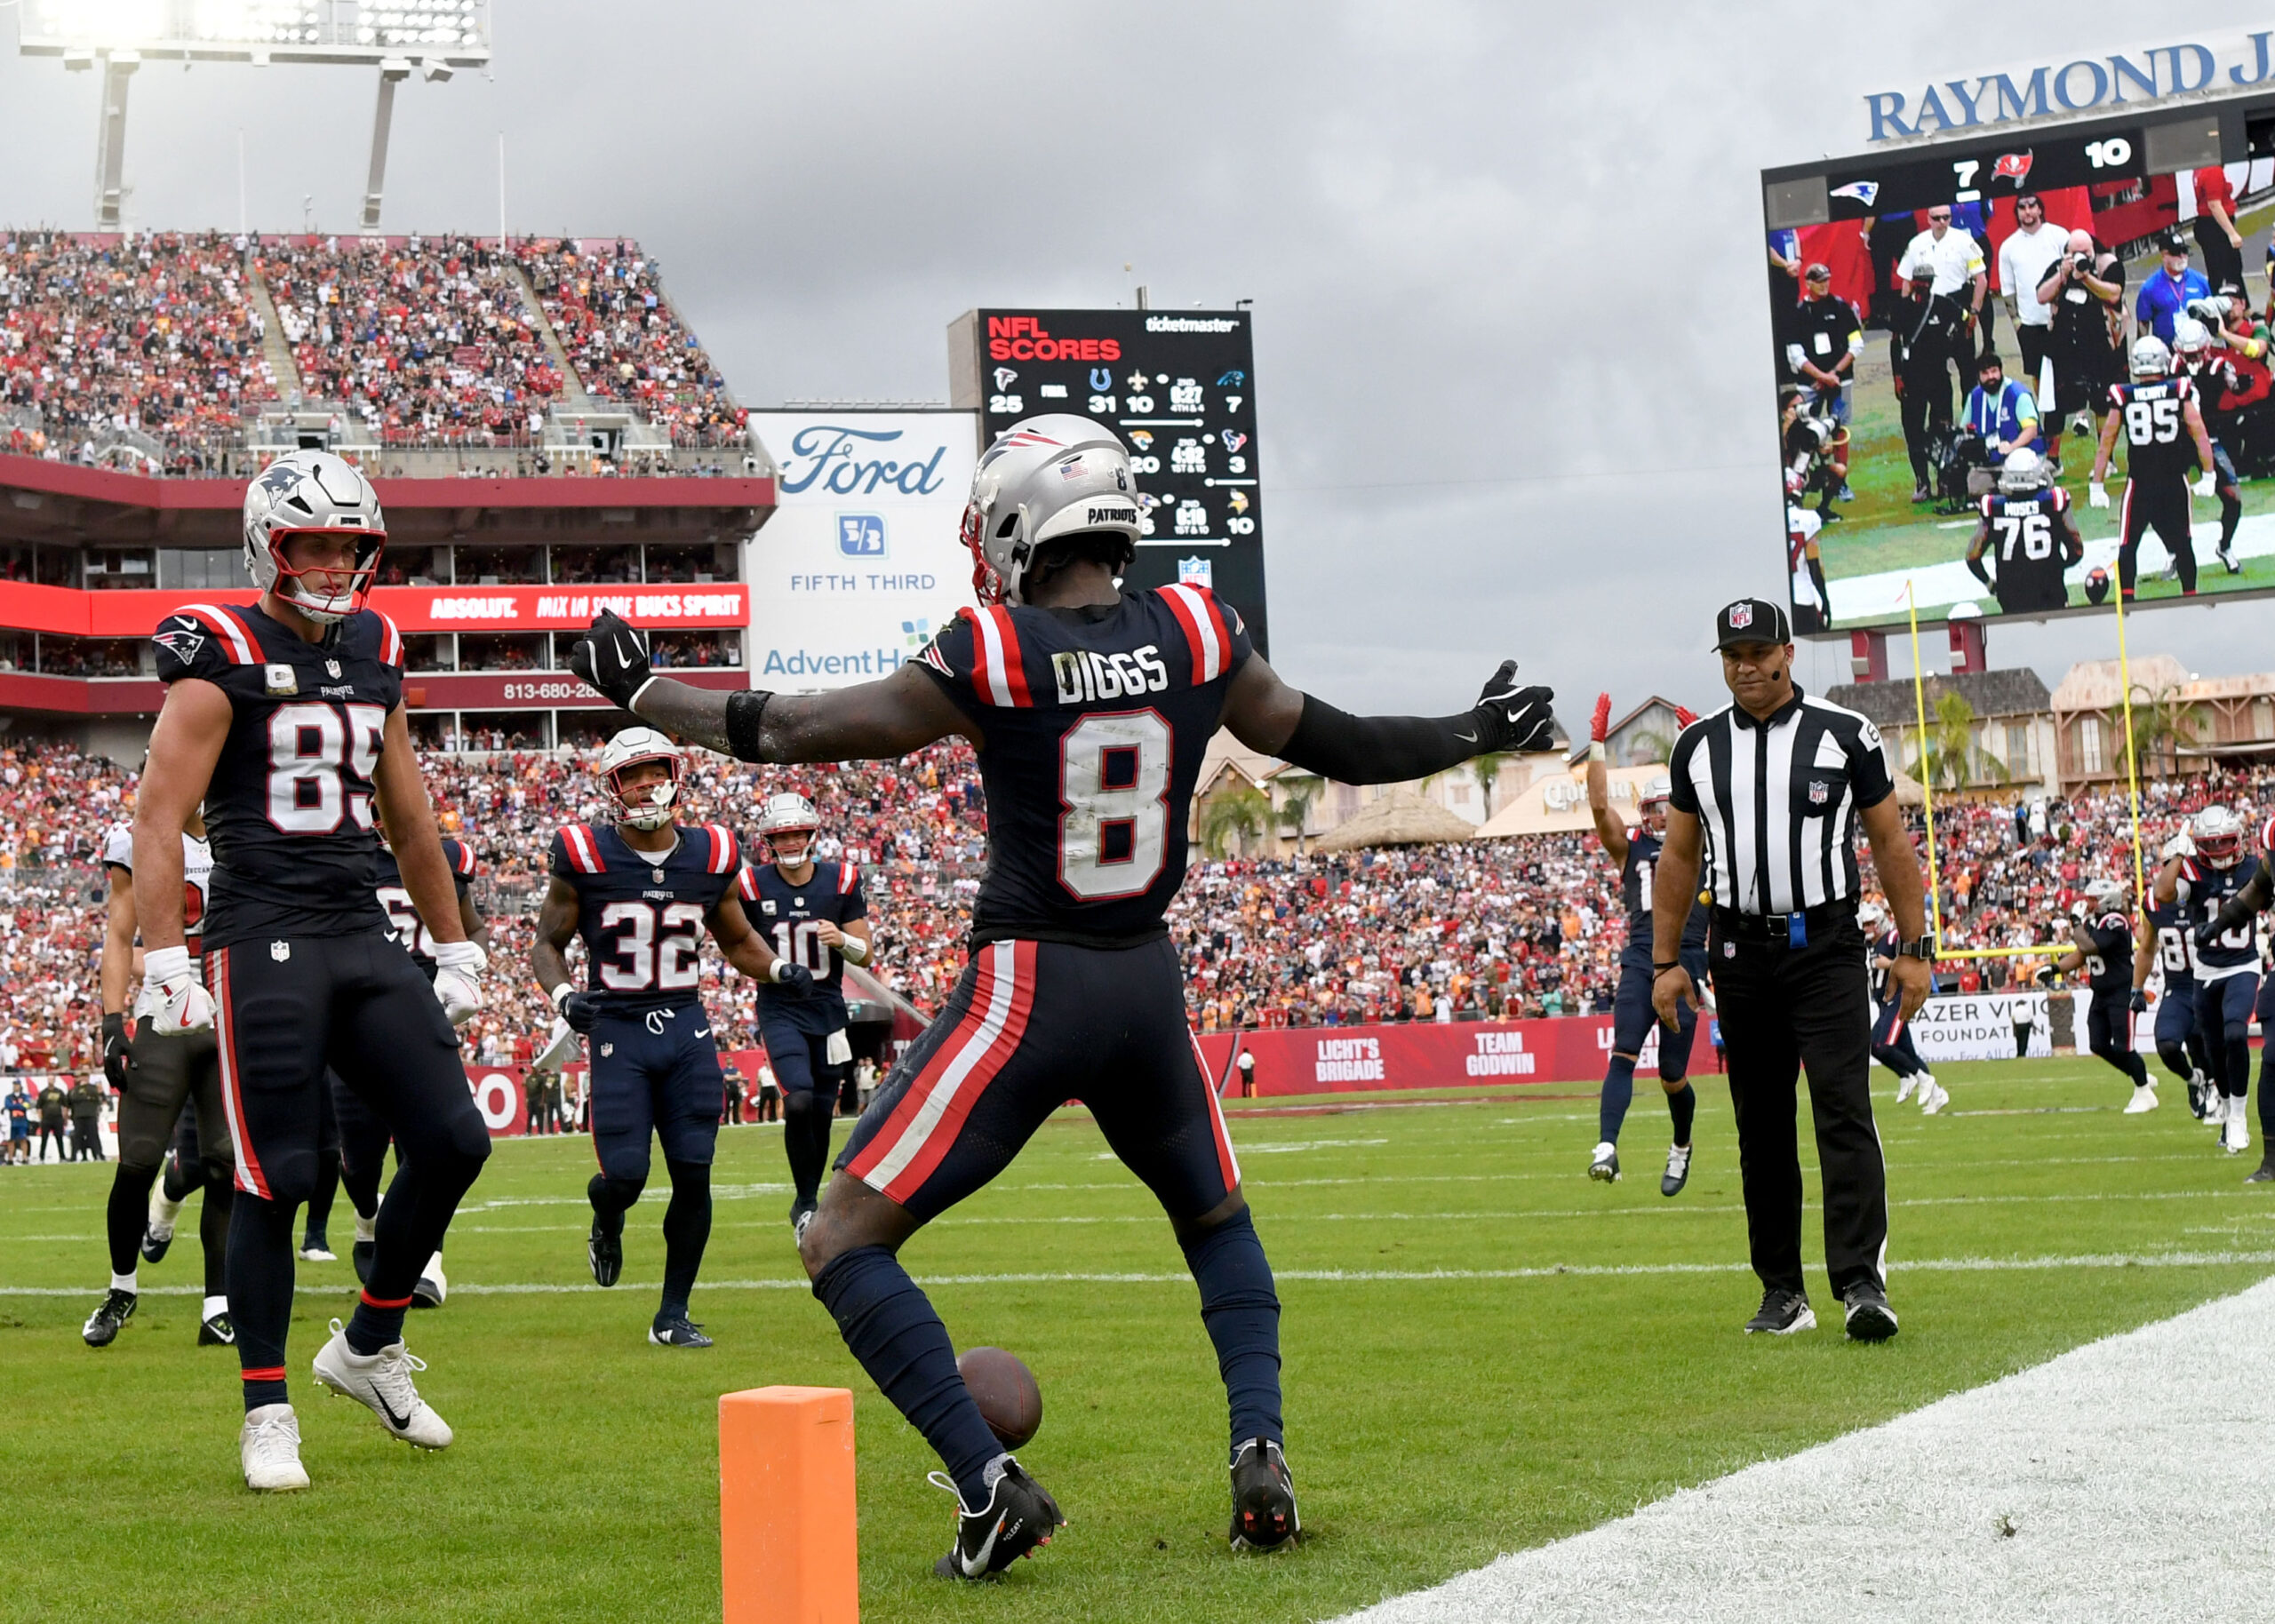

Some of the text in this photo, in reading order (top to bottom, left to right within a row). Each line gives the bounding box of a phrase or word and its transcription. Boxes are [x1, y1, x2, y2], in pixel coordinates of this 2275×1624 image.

[1864, 31, 2275, 142] RAYMOND J
[1953, 138, 2132, 189] 7 10
[988, 316, 1049, 338] NFL
[1145, 315, 1236, 333] ticketmaster
[989, 338, 1122, 361] SCORES
[989, 394, 1024, 413] 25
[1089, 394, 1116, 413] 31
[1126, 396, 1242, 413] 10 7
[2126, 398, 2179, 445] 85
[780, 426, 947, 495] Ford
[1130, 456, 1246, 474] 20 3
[1088, 508, 1137, 525] PATRIOTS
[1226, 517, 1255, 535] 10
[1993, 514, 2052, 561] 76
[791, 575, 935, 591] FIFTH THIRD
[635, 595, 682, 617] BUCS
[682, 594, 741, 617] SPIRIT
[1732, 613, 1750, 625] NFL
[1050, 645, 1169, 705] DIGGS
[320, 685, 355, 700] PATRIOTS
[503, 683, 605, 699] 813-680-28
[1057, 707, 1175, 902] 8
[1811, 790, 1826, 801] NFL
[185, 867, 212, 876] BUCCAN
[376, 887, 436, 959] 5
[600, 901, 705, 991] 32
[771, 920, 830, 980] 10
[1911, 1003, 1979, 1023] AZER
[1474, 1031, 1523, 1054] TEAM
[1921, 1024, 2044, 1043] FOUNDATN
[1317, 1038, 1380, 1061] LICHT'S
[1315, 1059, 1385, 1082] BRIGADE
[1466, 1053, 1536, 1076] GODWIN
